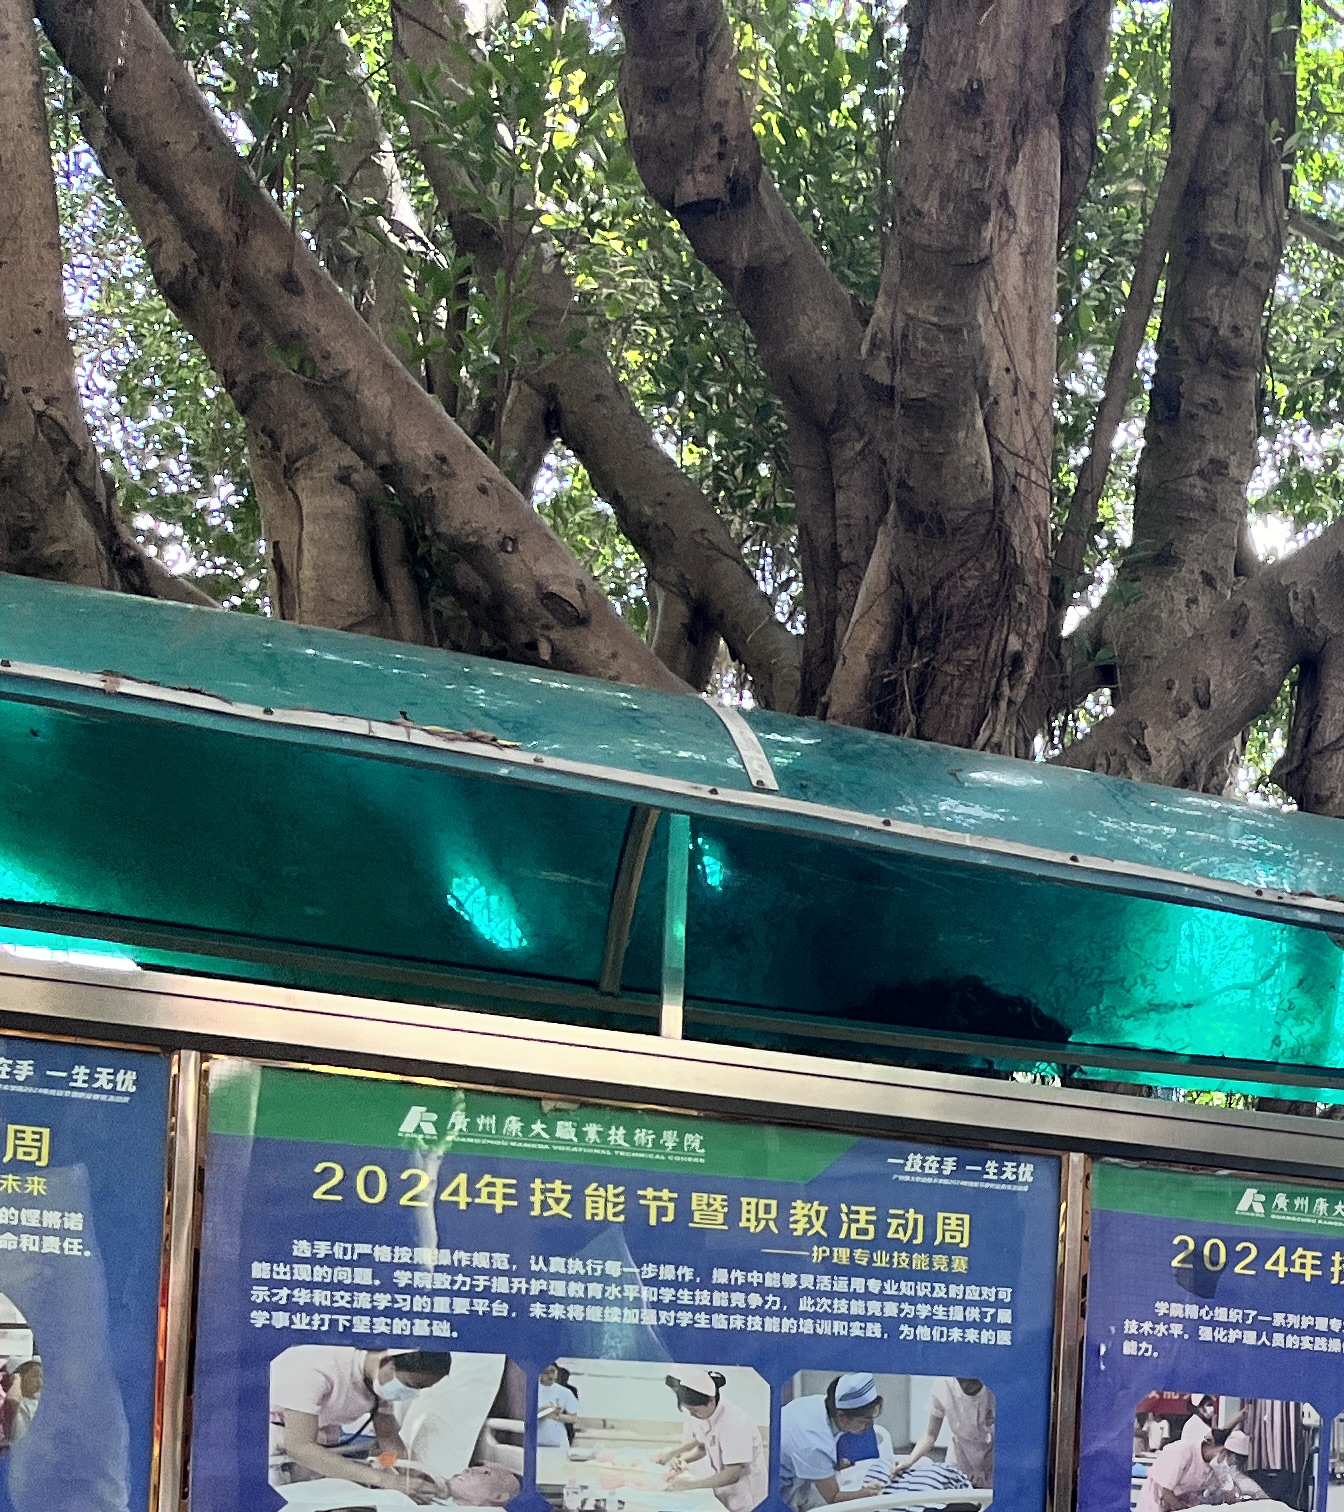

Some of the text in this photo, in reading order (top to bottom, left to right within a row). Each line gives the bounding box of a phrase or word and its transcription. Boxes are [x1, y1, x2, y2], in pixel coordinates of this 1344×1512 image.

[2, 1124, 51, 1167] 周
[887, 1152, 958, 1176] 一技在手
[0, 1173, 47, 1196] 未来
[312, 1161, 971, 1249] 2024年技能节暨职教活动周
